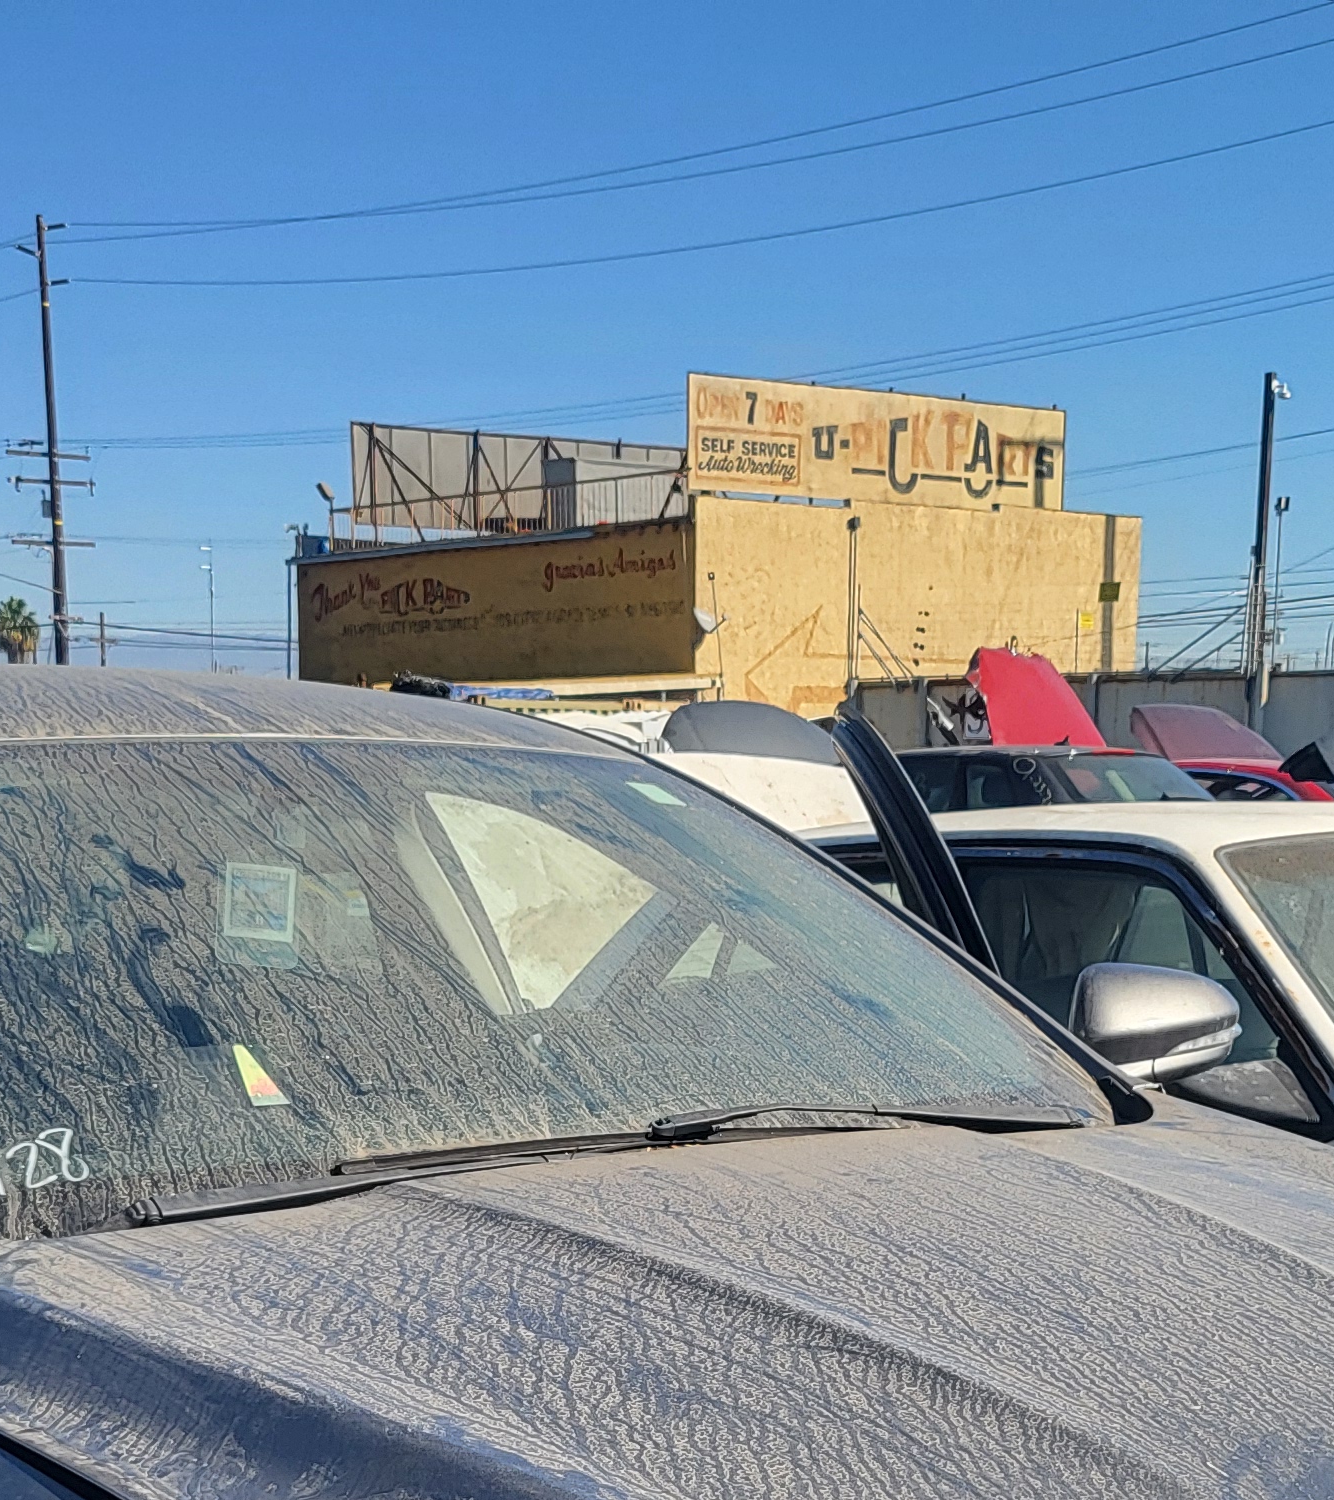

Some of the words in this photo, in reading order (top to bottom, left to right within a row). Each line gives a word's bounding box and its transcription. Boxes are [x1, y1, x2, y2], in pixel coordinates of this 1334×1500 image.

[696, 385, 740, 421] OPEN
[745, 391, 758, 425] 7
[765, 399, 804, 426] DAYS
[701, 437, 735, 454] SELF
[741, 440, 796, 459] SERVICE
[941, 411, 1054, 498] PARTS
[698, 455, 734, 473] Auto
[734, 456, 797, 483] Wrecking
[311, 581, 357, 622] Thank
